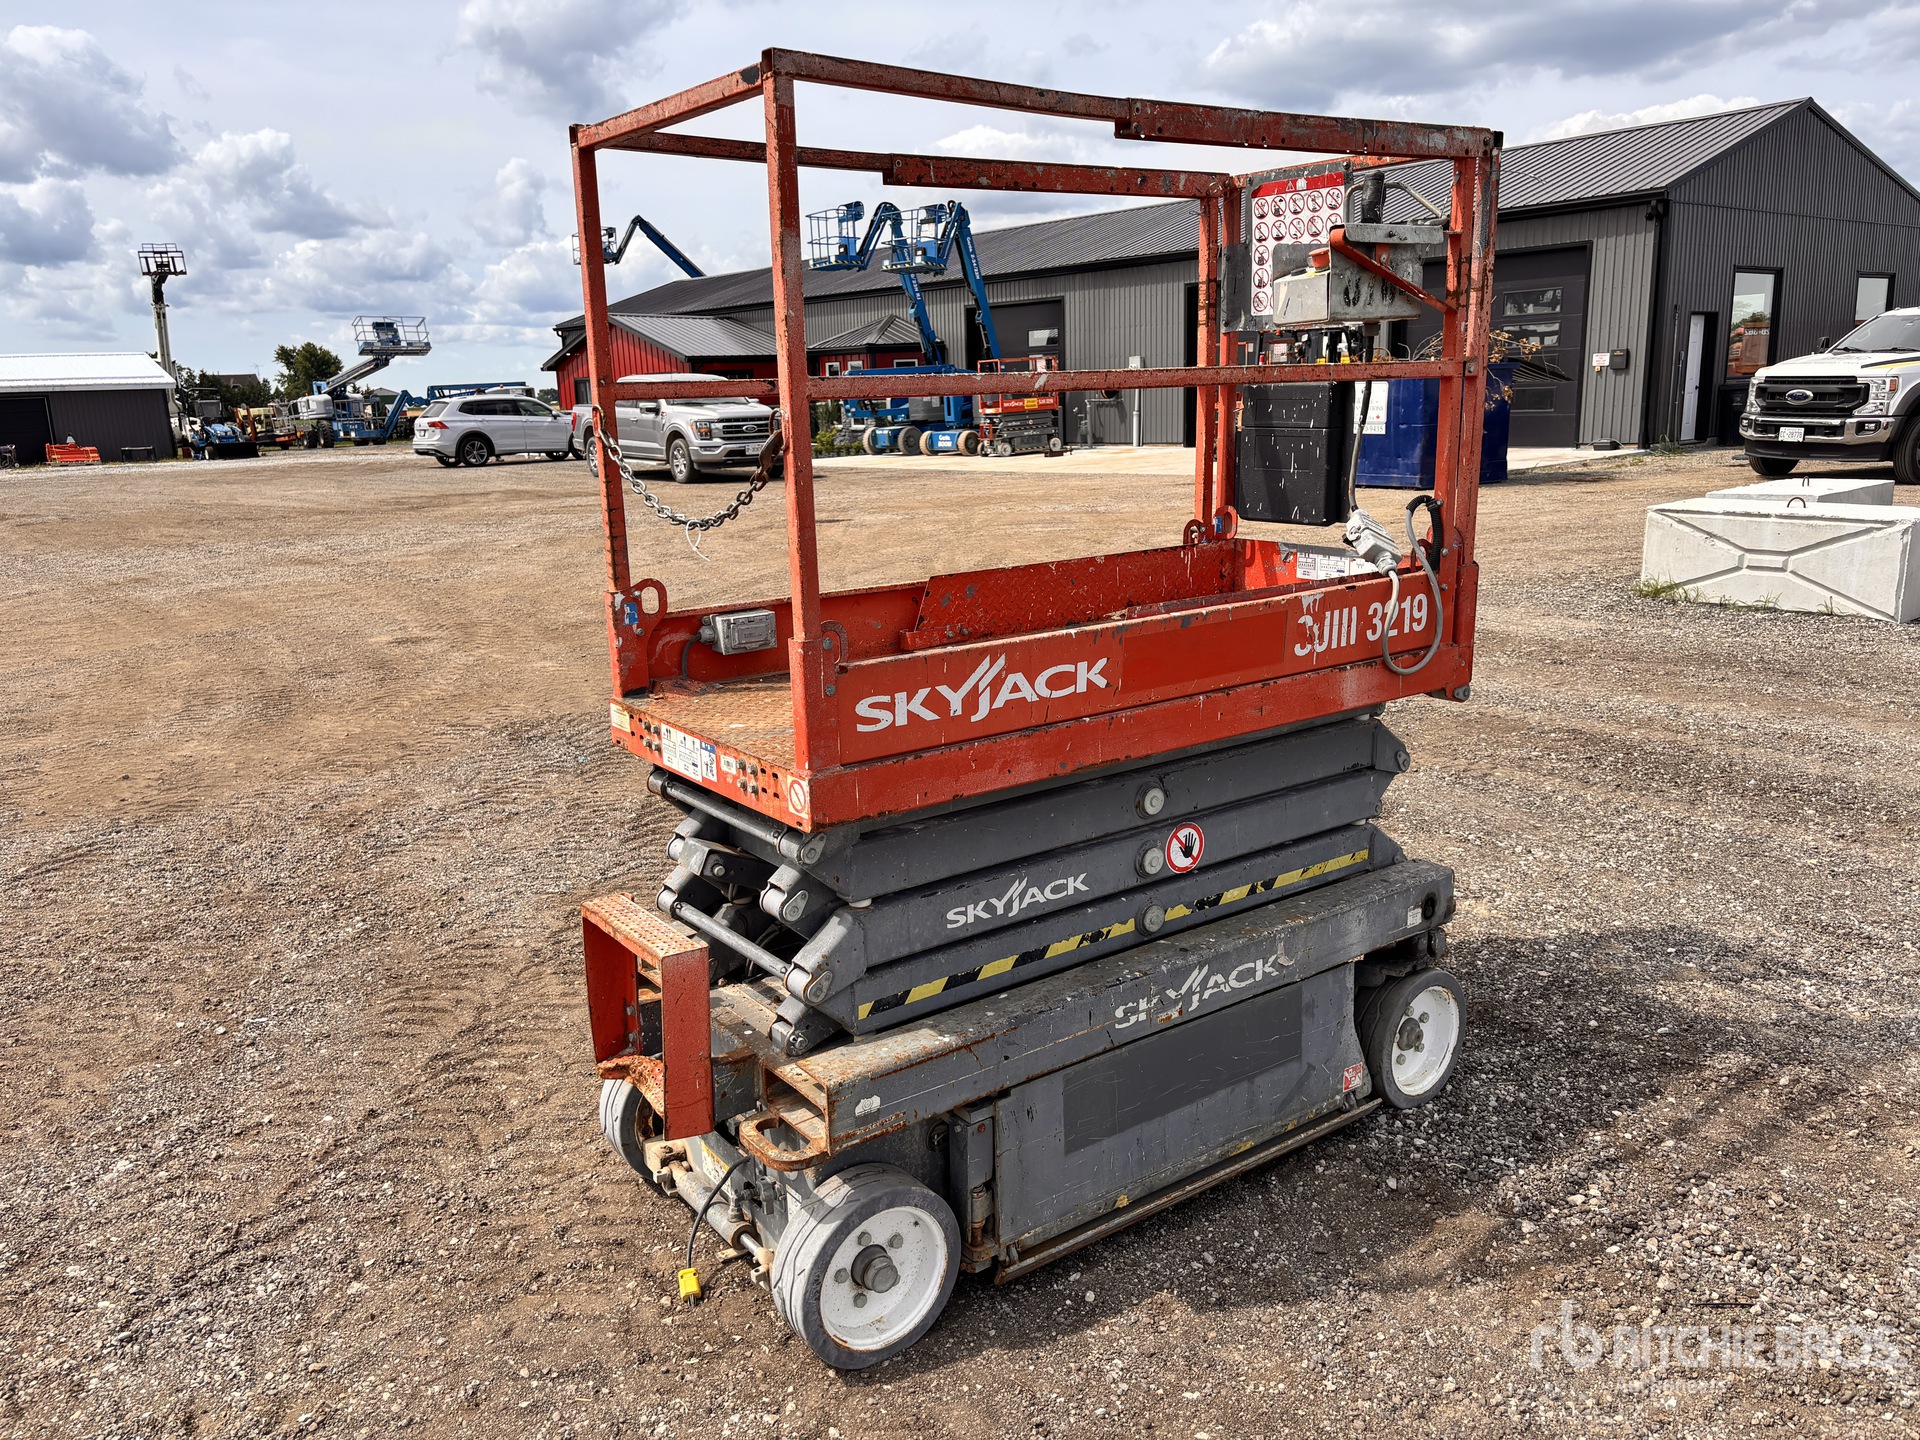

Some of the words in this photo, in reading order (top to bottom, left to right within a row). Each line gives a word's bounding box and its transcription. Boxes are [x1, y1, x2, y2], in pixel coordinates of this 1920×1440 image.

[1366, 593, 1428, 642] 3219
[855, 653, 1109, 732] SKYJACK
[946, 872, 1090, 929] SKYJACK
